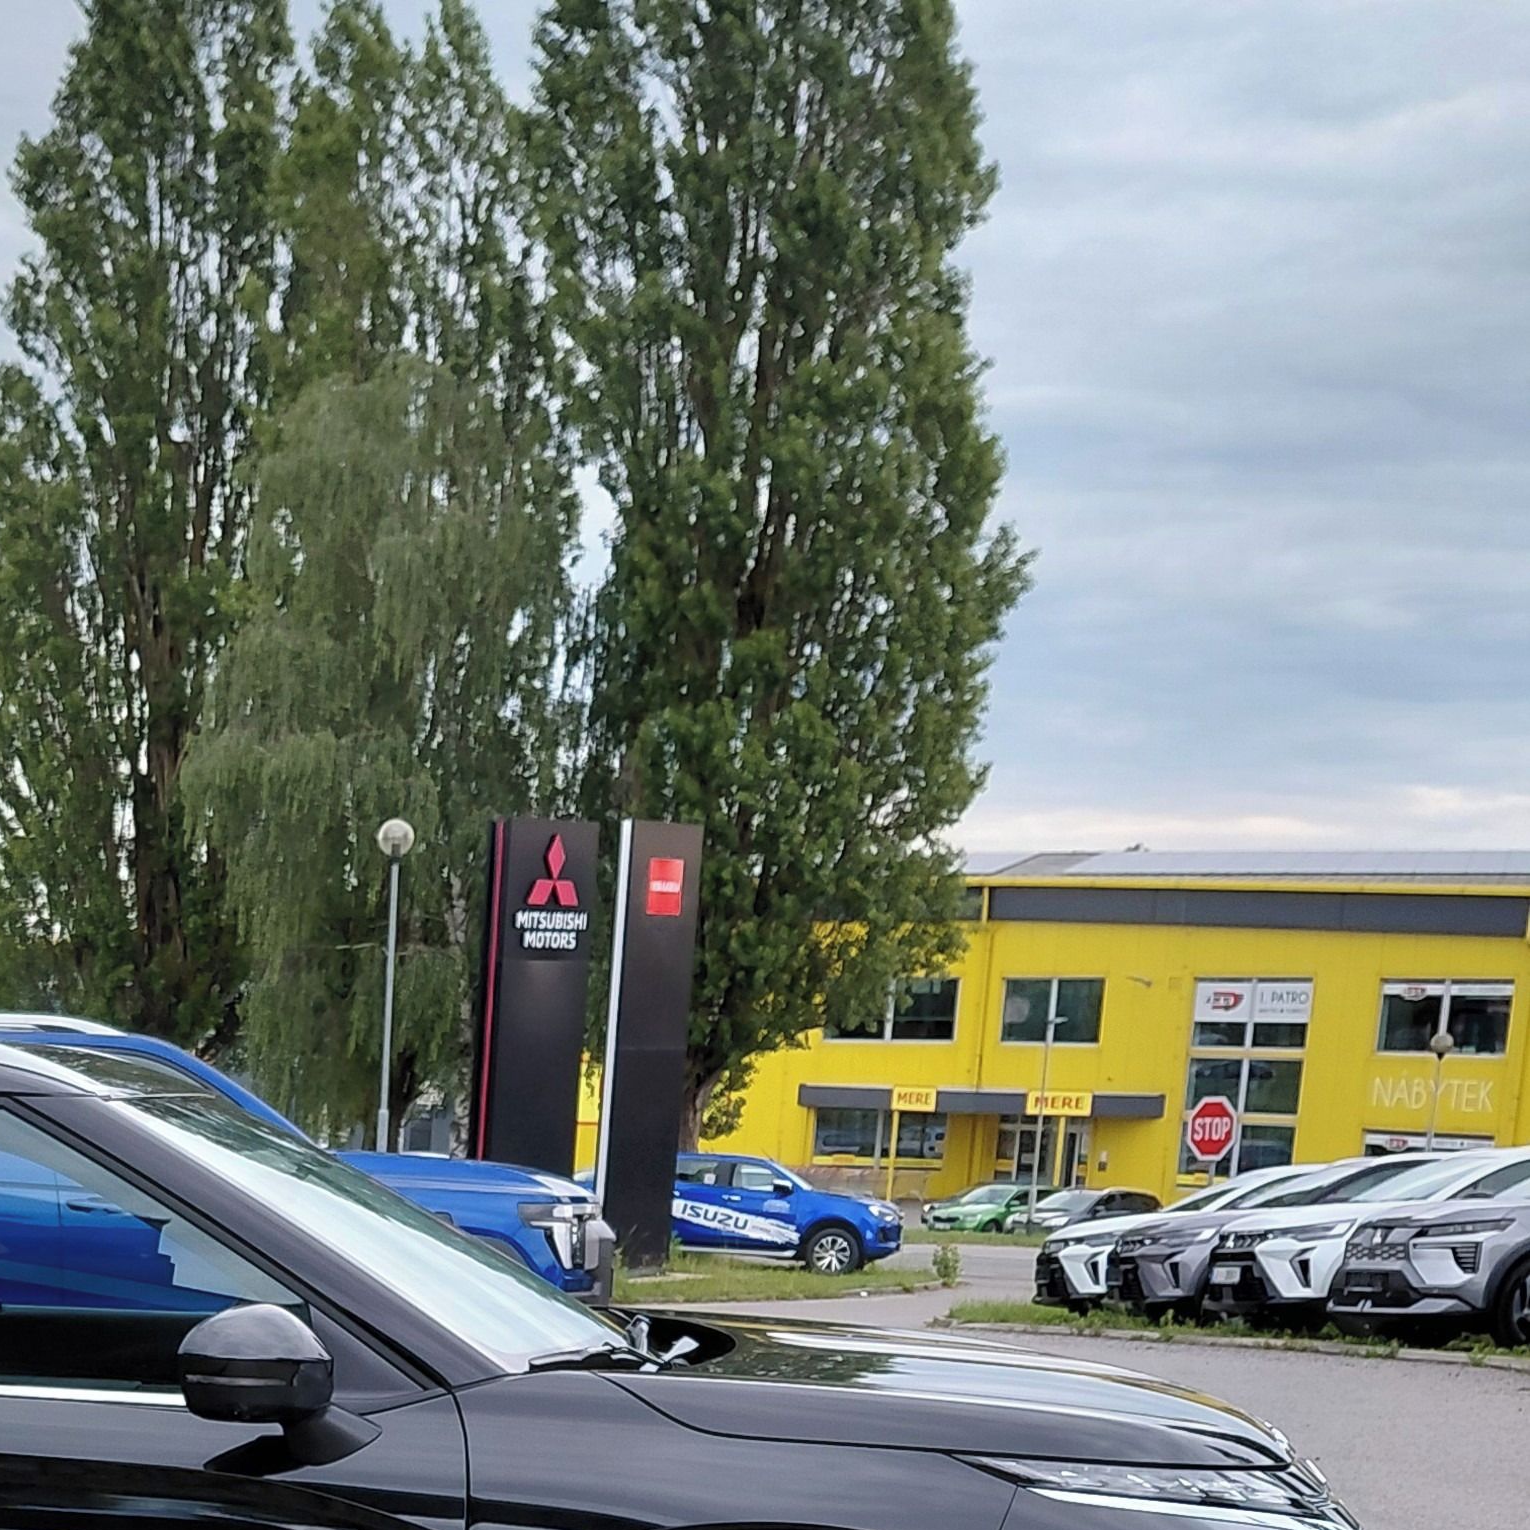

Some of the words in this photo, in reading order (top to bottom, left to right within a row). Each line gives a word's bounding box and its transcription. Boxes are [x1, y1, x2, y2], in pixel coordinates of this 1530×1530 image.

[515, 910, 588, 931] MITSUBISHI
[523, 931, 577, 950] MOTORS
[1271, 991, 1310, 1005] PATRO
[897, 1091, 932, 1106] MERE
[1372, 1070, 1494, 1113] NÁBYTEK
[1034, 1096, 1084, 1111] MERE
[1193, 1116, 1231, 1141] STOP
[681, 1203, 749, 1231] ISUZU
